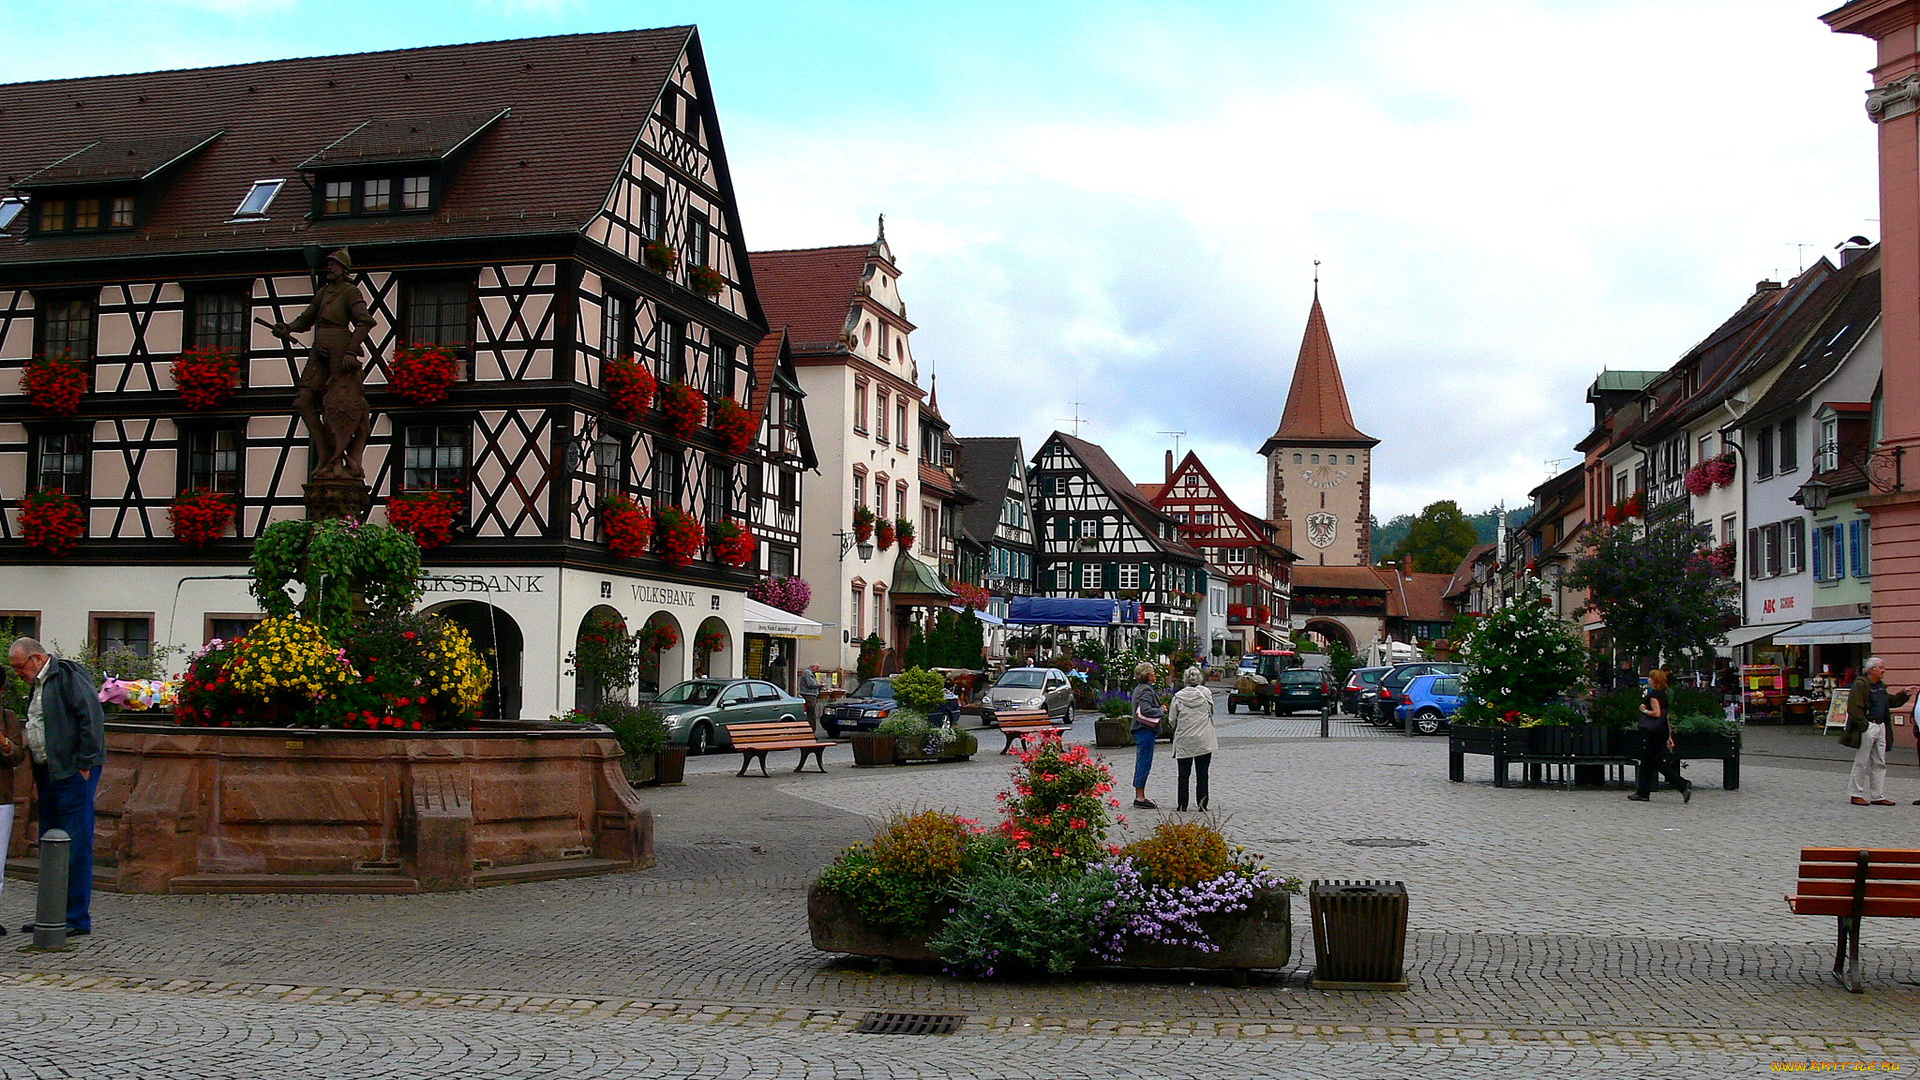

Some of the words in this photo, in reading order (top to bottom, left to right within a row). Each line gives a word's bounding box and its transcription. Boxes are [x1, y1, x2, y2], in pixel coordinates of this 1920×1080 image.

[417, 575, 544, 592] LKSBANK
[631, 584, 696, 607] VOLKSBANK
[1763, 599, 1776, 614] ABC
